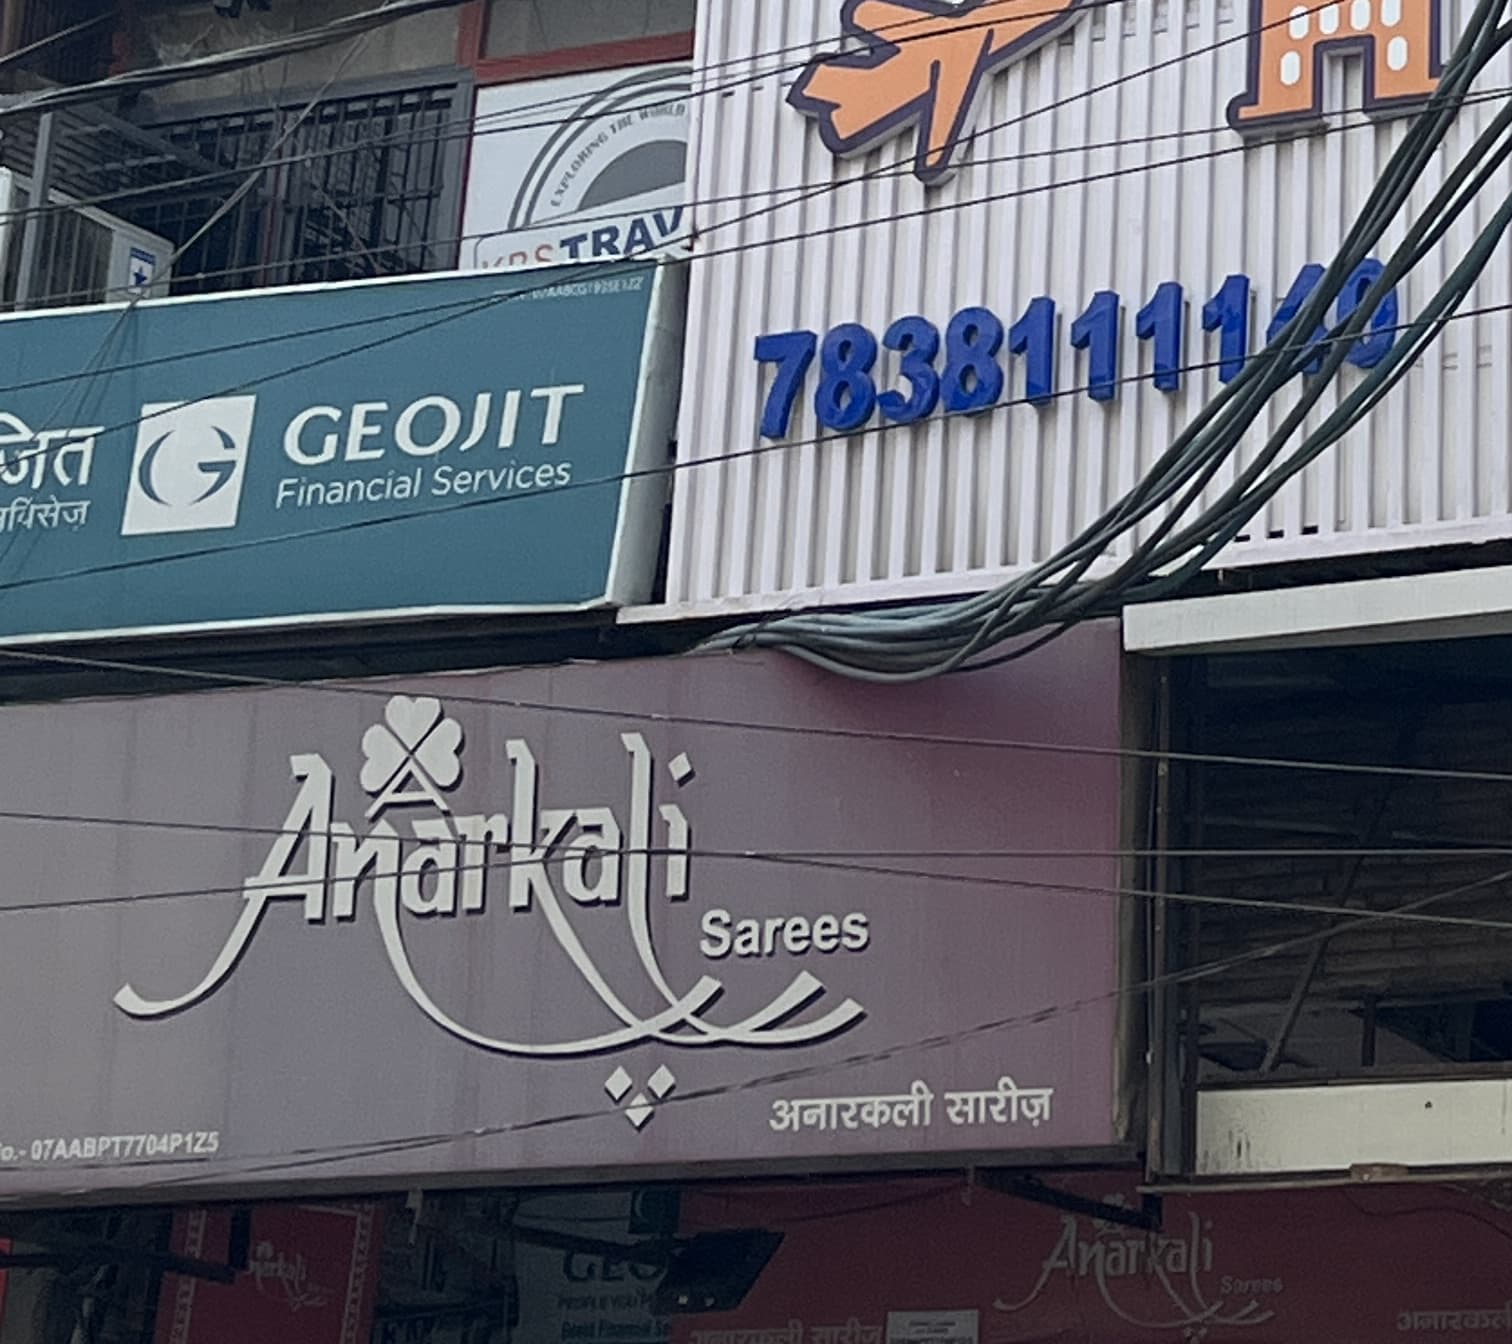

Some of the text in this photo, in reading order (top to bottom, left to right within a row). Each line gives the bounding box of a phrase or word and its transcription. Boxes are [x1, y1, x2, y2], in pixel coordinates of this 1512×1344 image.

[282, 384, 586, 469] GEOJIT
[275, 461, 572, 509] Financial Services
[701, 909, 870, 958] Sarees
[769, 1075, 1054, 1132] अनारकली सारीज़
